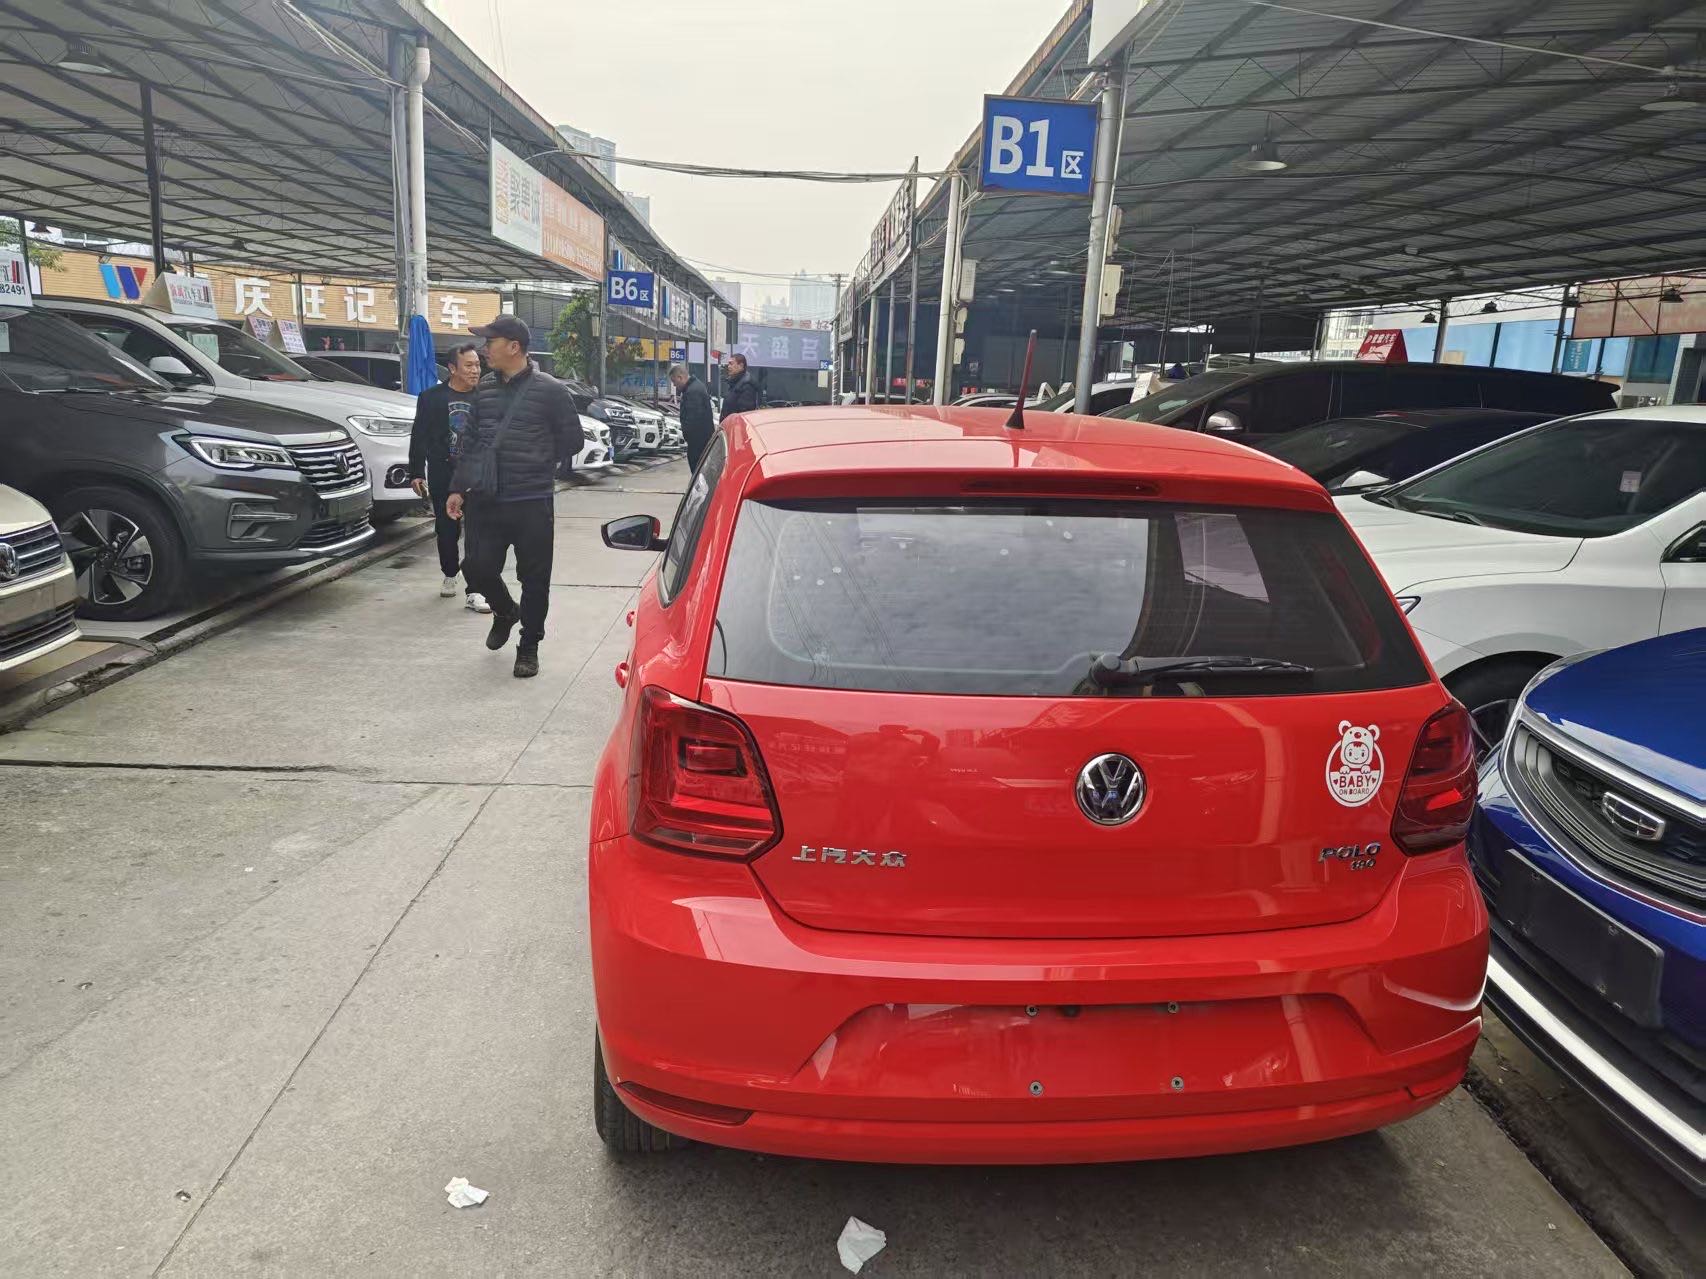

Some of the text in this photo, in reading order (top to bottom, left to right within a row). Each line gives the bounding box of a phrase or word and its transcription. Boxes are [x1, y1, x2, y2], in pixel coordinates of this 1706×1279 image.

[990, 115, 1084, 179] B1区
[610, 276, 649, 302] B6区
[1339, 774, 1372, 788] BABY
[1339, 787, 1370, 796] ON BOARD
[792, 845, 907, 868] 上汽大众
[1318, 842, 1381, 862] POLO
